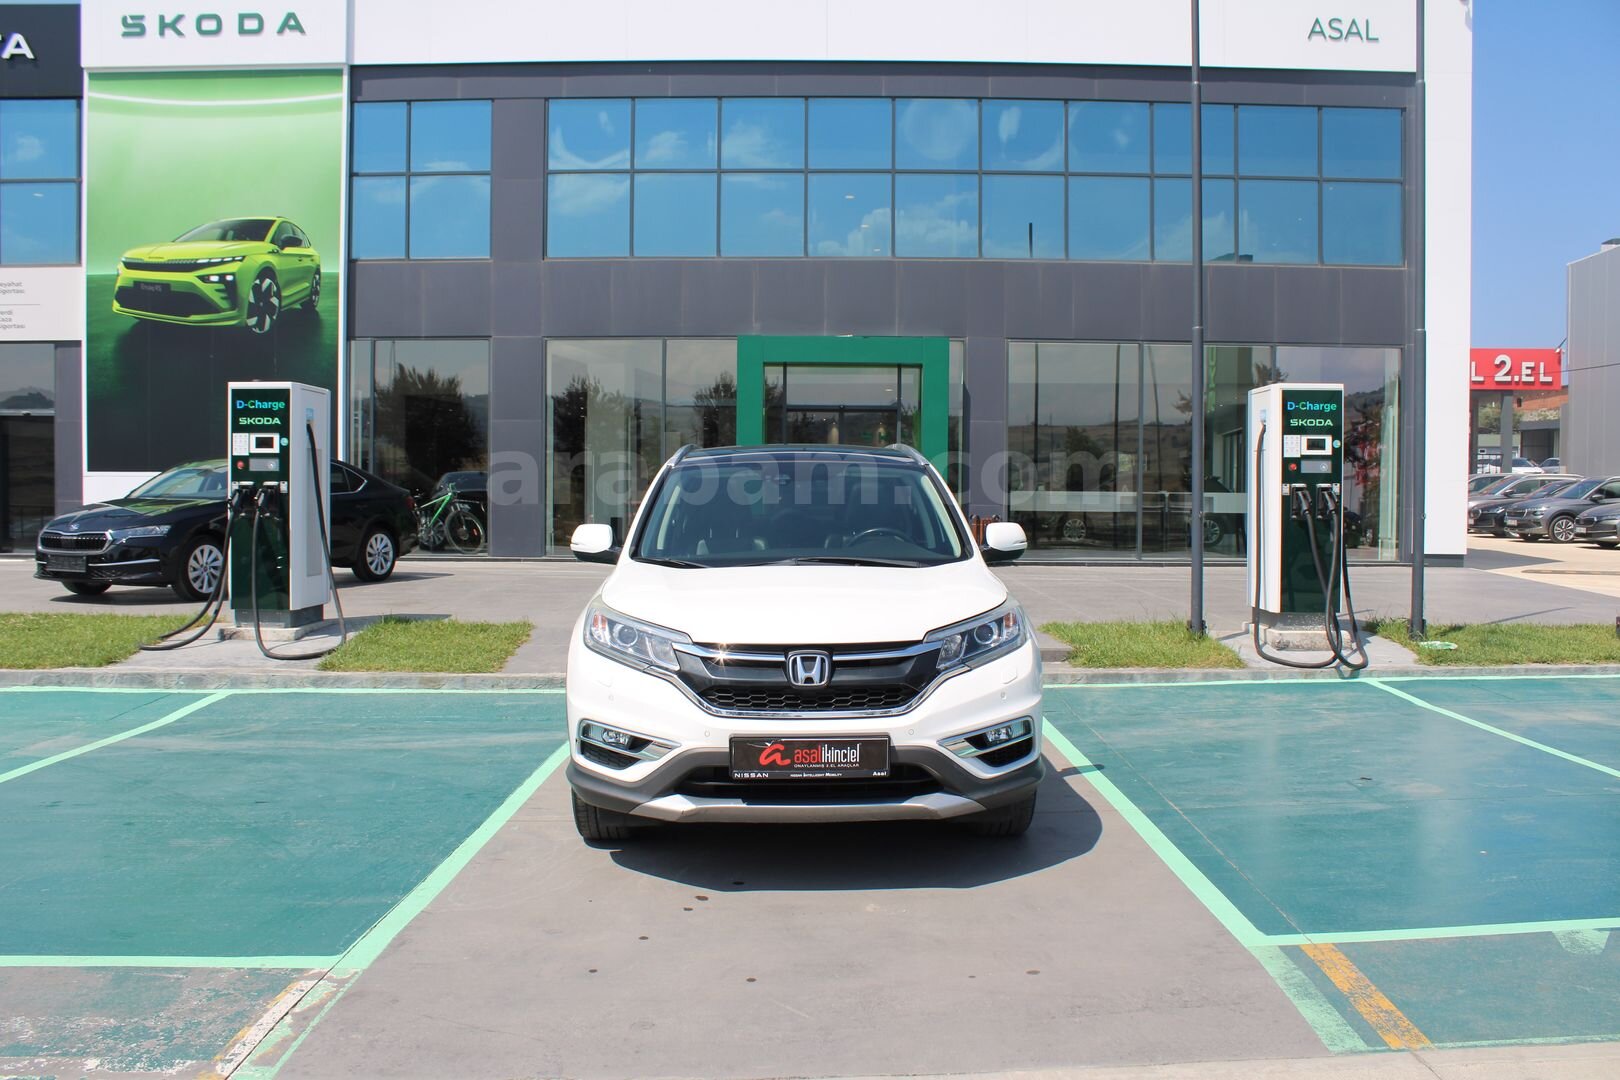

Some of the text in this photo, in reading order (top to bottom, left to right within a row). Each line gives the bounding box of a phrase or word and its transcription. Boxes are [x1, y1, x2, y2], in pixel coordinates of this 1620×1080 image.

[1307, 17, 1379, 41] ASAL
[1494, 354, 1553, 382] 2.EL
[236, 400, 285, 411] D-Charge
[1287, 401, 1337, 412] D-Charge
